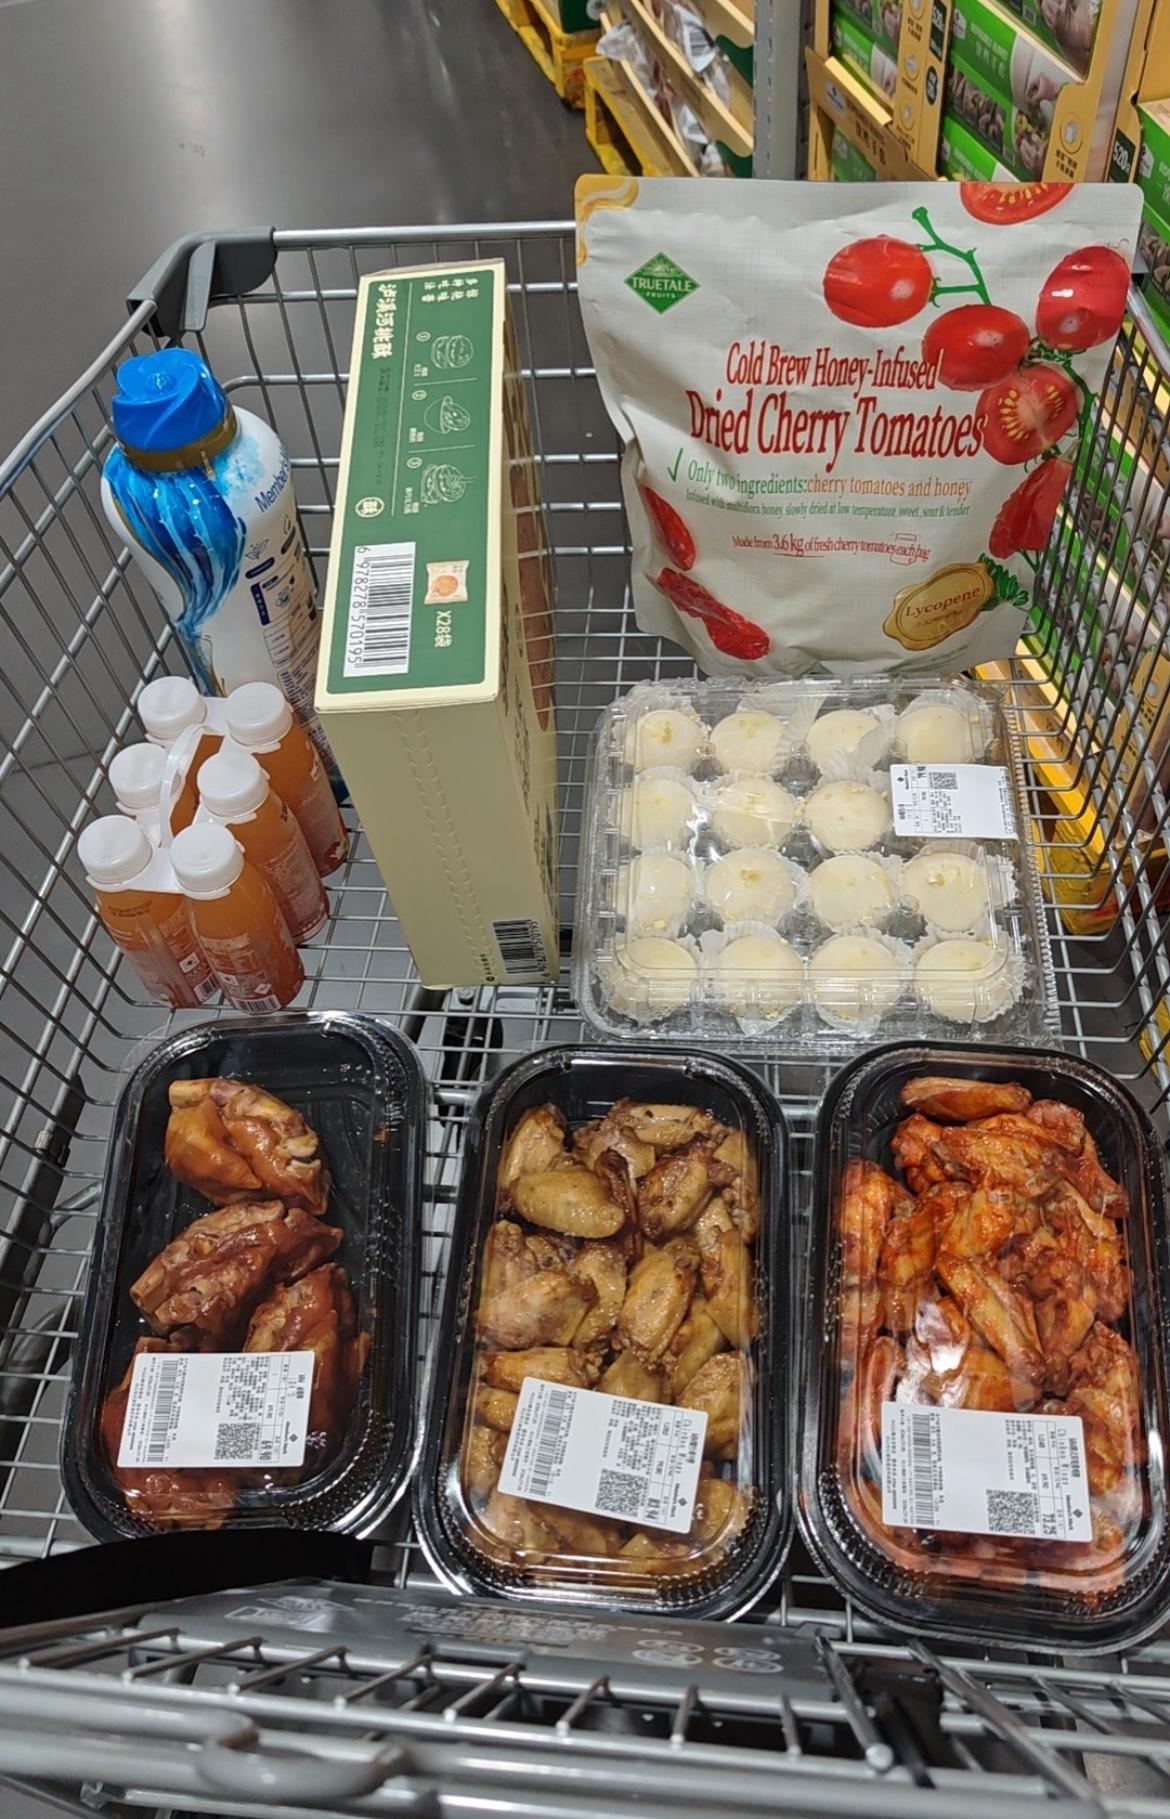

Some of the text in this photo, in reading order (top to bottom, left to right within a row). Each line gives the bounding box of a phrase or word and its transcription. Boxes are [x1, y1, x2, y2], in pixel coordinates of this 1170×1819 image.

[631, 277, 694, 292] TRUETALE
[371, 283, 398, 360] 泸溪河桃酥
[726, 340, 945, 399] Cold Brew Honey-Infused
[686, 388, 988, 474] Dried Cherry Tomatoes
[688, 459, 715, 491] Only
[717, 470, 735, 490] two
[850, 476, 904, 497] tomatoes
[907, 476, 932, 497] and
[934, 476, 973, 503] honey
[808, 501, 829, 515] dried
[838, 501, 850, 514] low
[946, 503, 971, 517] tender
[732, 536, 754, 548] Made
[754, 535, 772, 549] from
[805, 536, 815, 551] of
[814, 536, 833, 551] fresh
[834, 536, 861, 556] cherry
[861, 539, 896, 555] tomatoes
[906, 587, 980, 619] Lycopene
[347, 615, 366, 664] 570195
